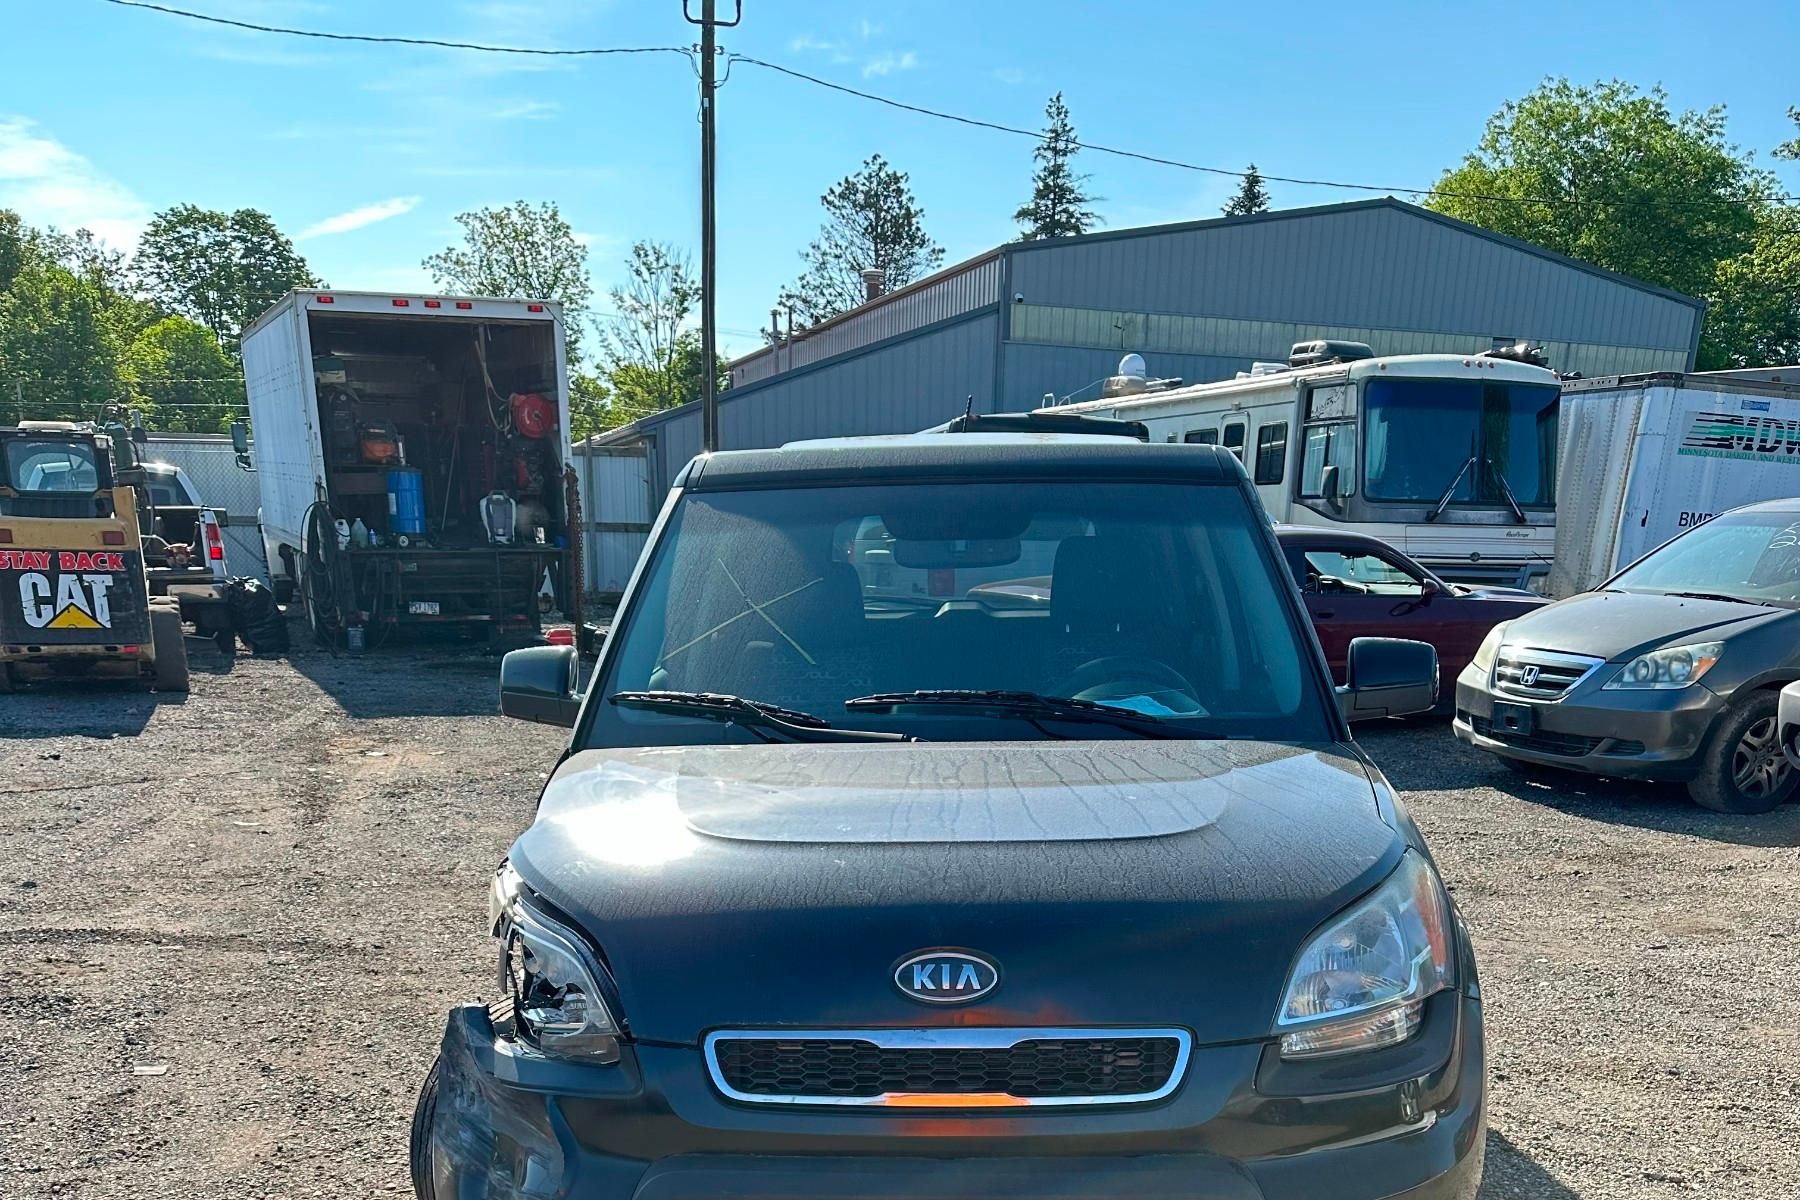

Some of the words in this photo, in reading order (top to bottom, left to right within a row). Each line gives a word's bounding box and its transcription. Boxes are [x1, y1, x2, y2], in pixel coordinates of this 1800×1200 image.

[1678, 448, 1724, 458] MINNESOTA
[1726, 452, 1757, 460] DAKOTA
[1760, 454, 1775, 462] AND
[0, 550, 51, 570] STAY
[58, 551, 127, 571] BACK
[19, 572, 113, 628] CAT
[912, 963, 981, 990] KIA
